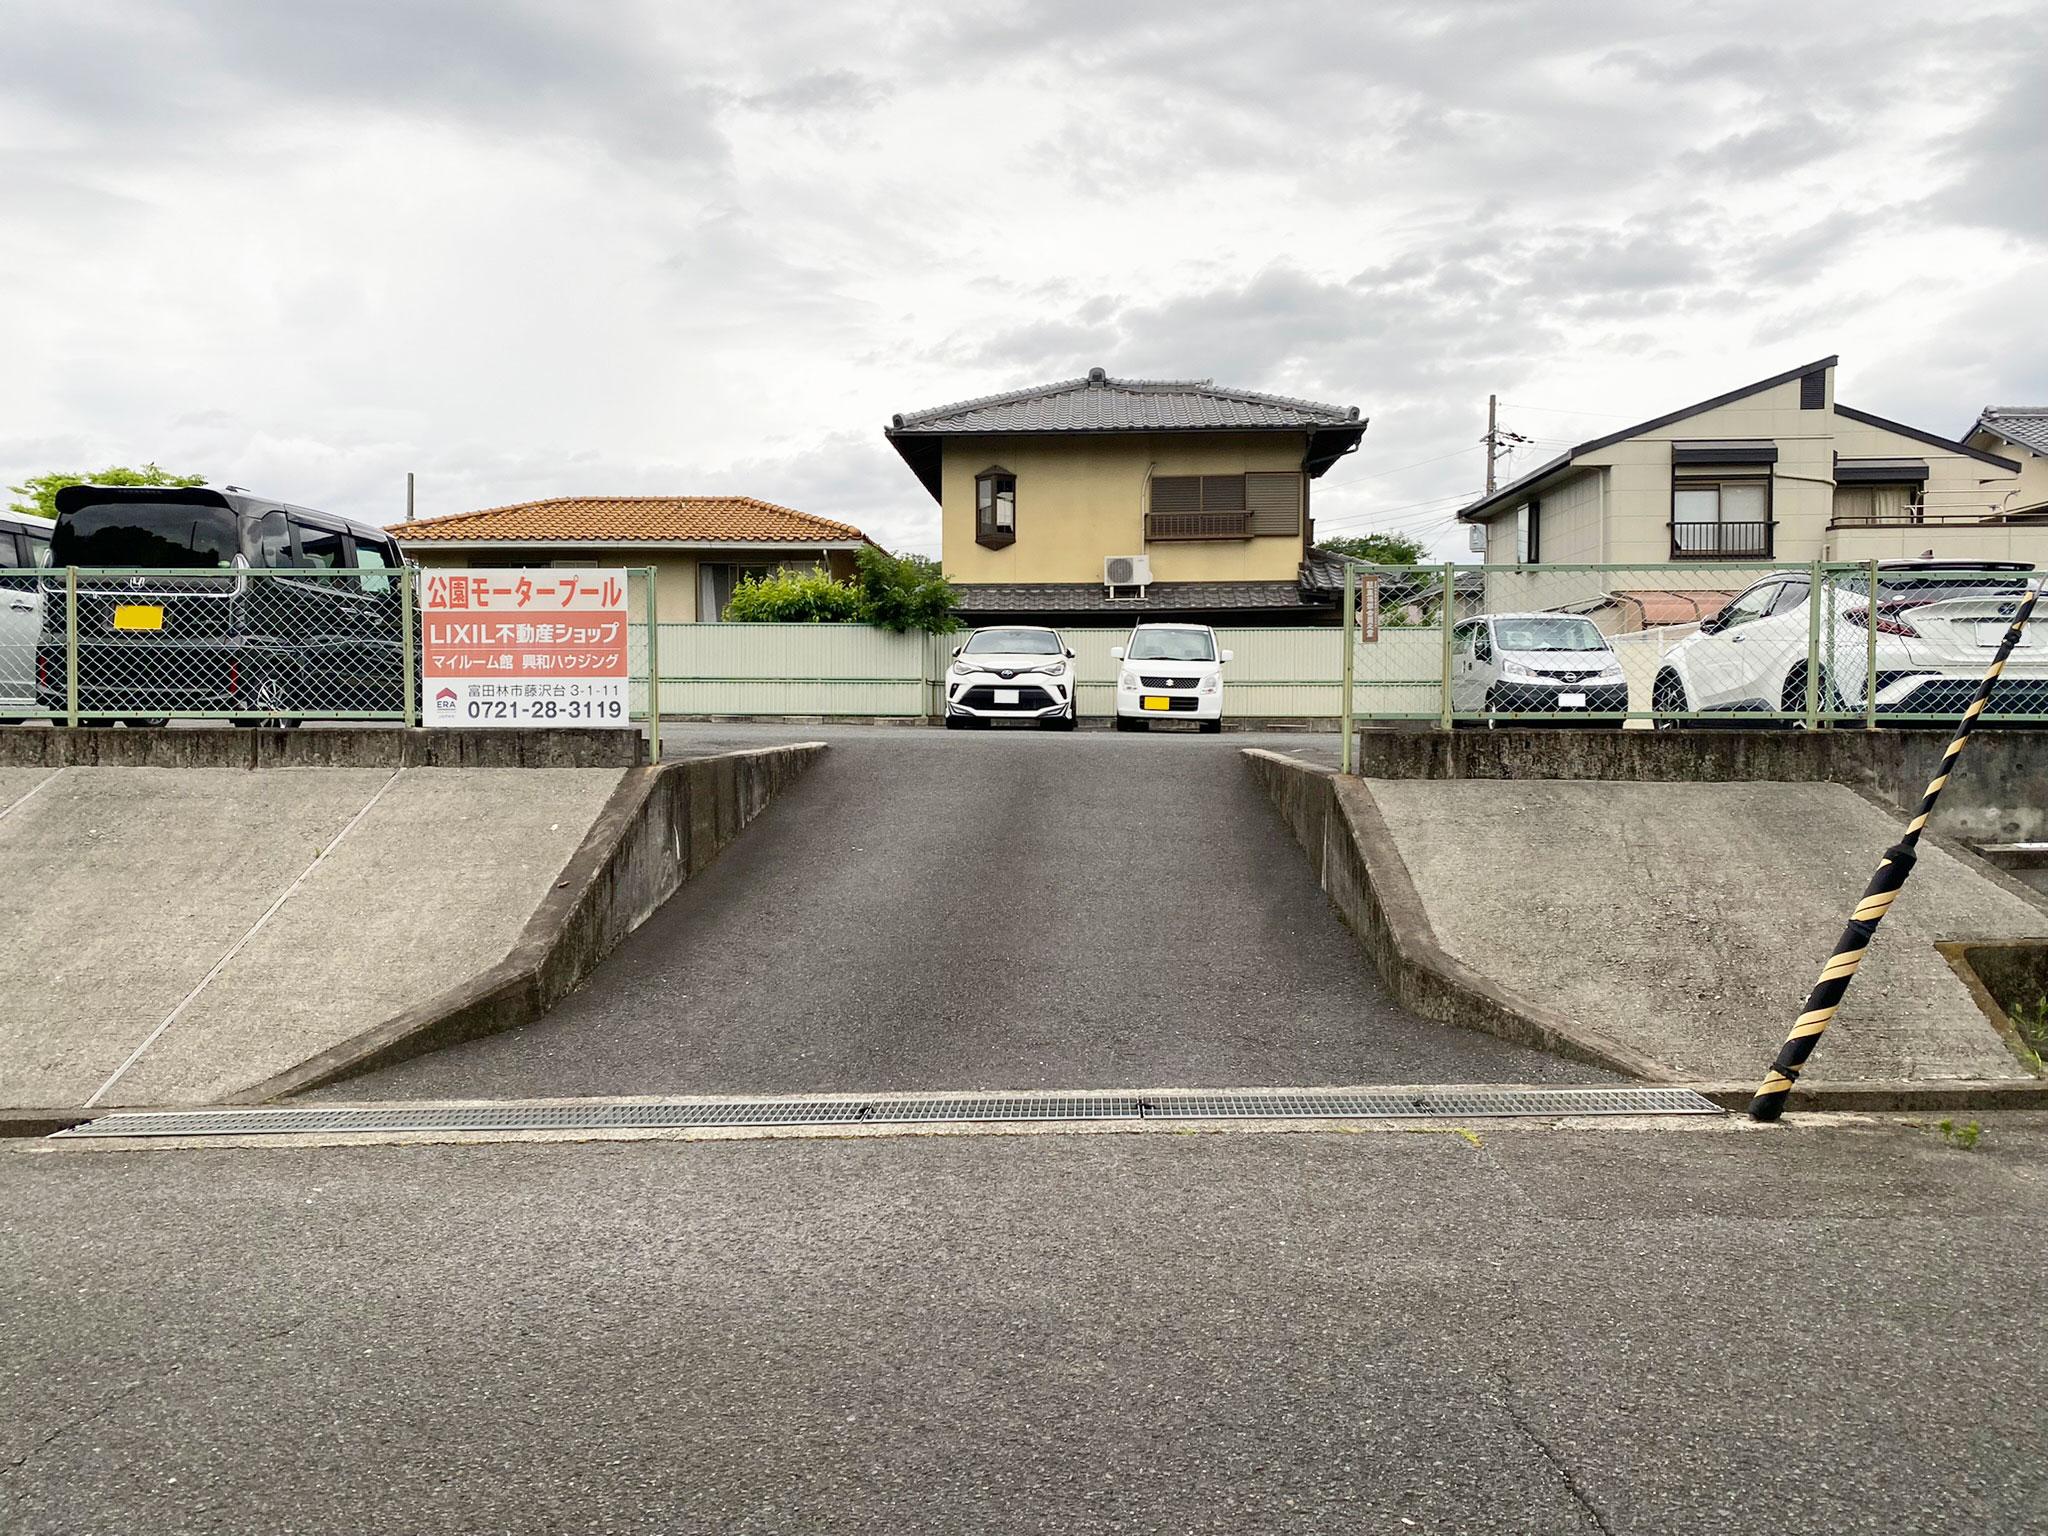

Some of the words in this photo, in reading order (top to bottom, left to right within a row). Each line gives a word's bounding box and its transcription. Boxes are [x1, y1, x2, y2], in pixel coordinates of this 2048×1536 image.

[427, 574, 622, 609] 公園モータープール
[430, 621, 619, 644] LIXIL不動産ショップ
[432, 654, 513, 669] マイルーム館
[522, 653, 619, 669] 興和ハウジング
[468, 701, 621, 718] 0721-28-3119
